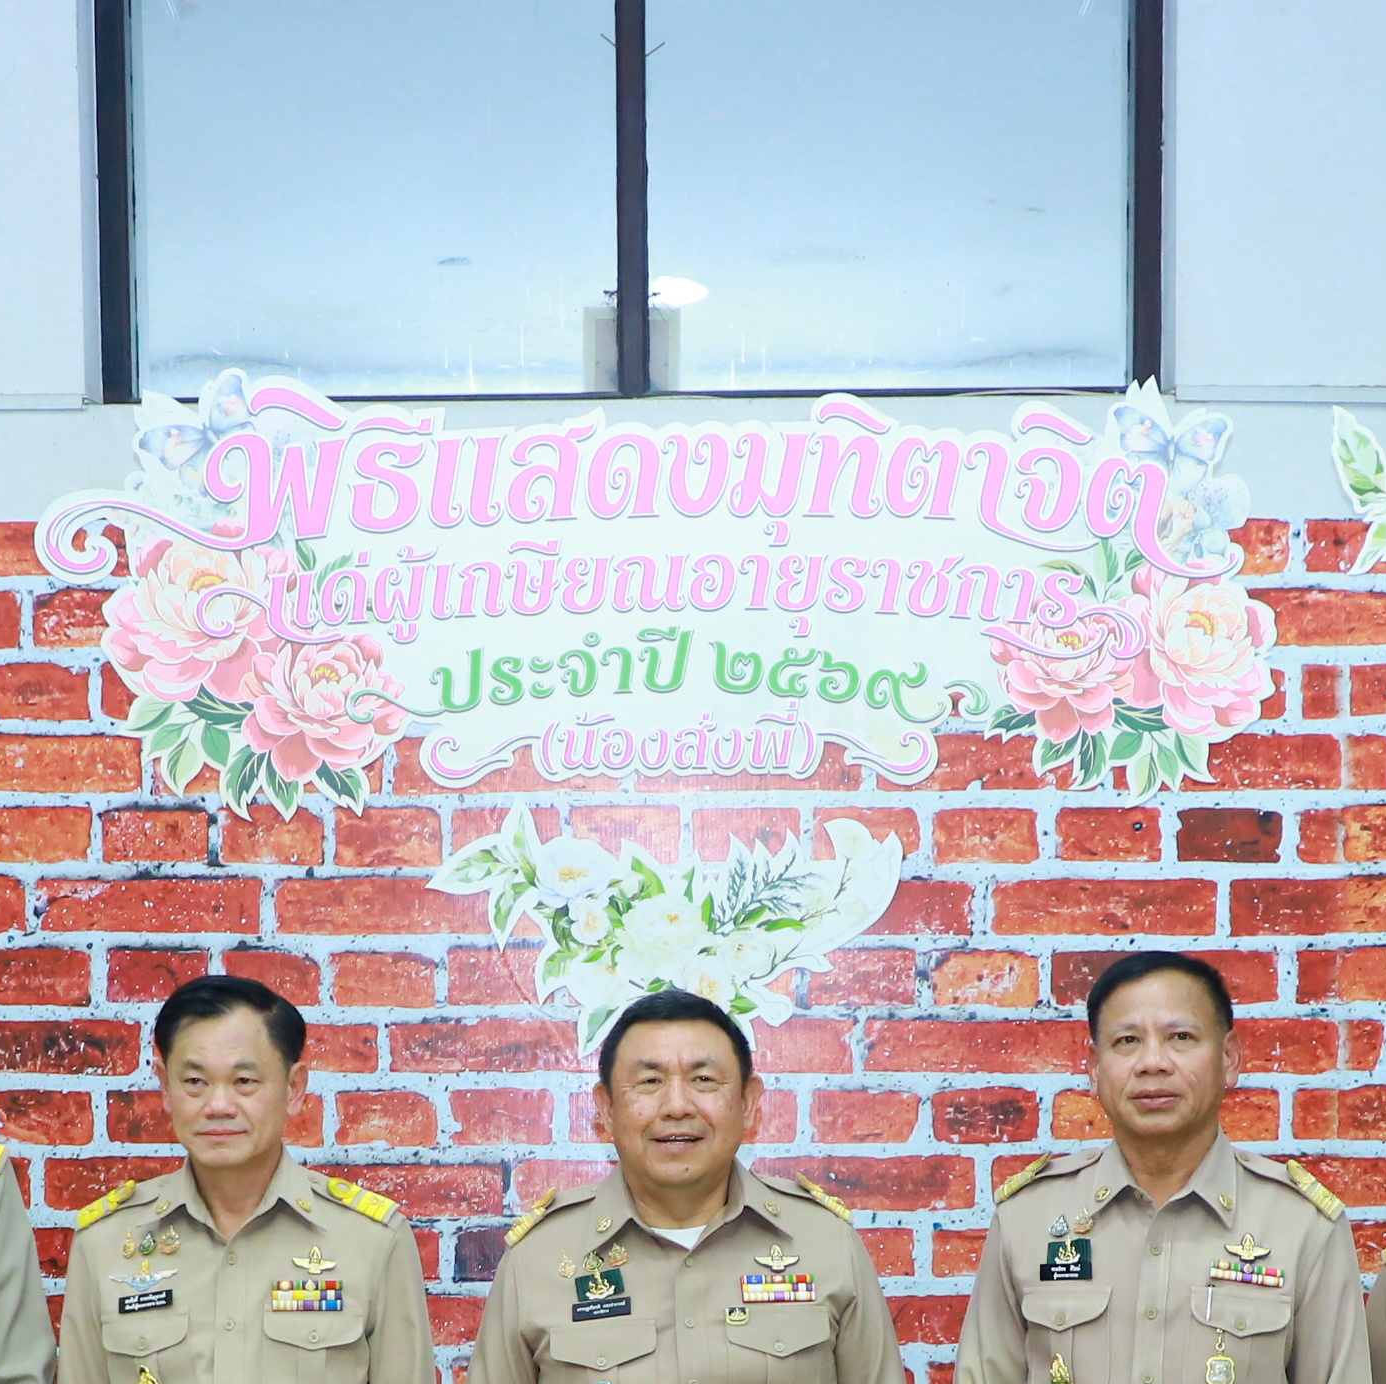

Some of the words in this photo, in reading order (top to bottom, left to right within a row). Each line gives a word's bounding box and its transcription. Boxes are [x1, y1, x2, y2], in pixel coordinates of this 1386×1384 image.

[45, 386, 1238, 577] พิธีแสดงมุทิตาจิต
[197, 539, 1145, 659] แด่ผู้เกษียณอายุราชการ
[348, 626, 695, 716] ประจำปี
[710, 640, 946, 722] ๒๕๖๙
[539, 700, 818, 774] (น้องส่งพี่)
